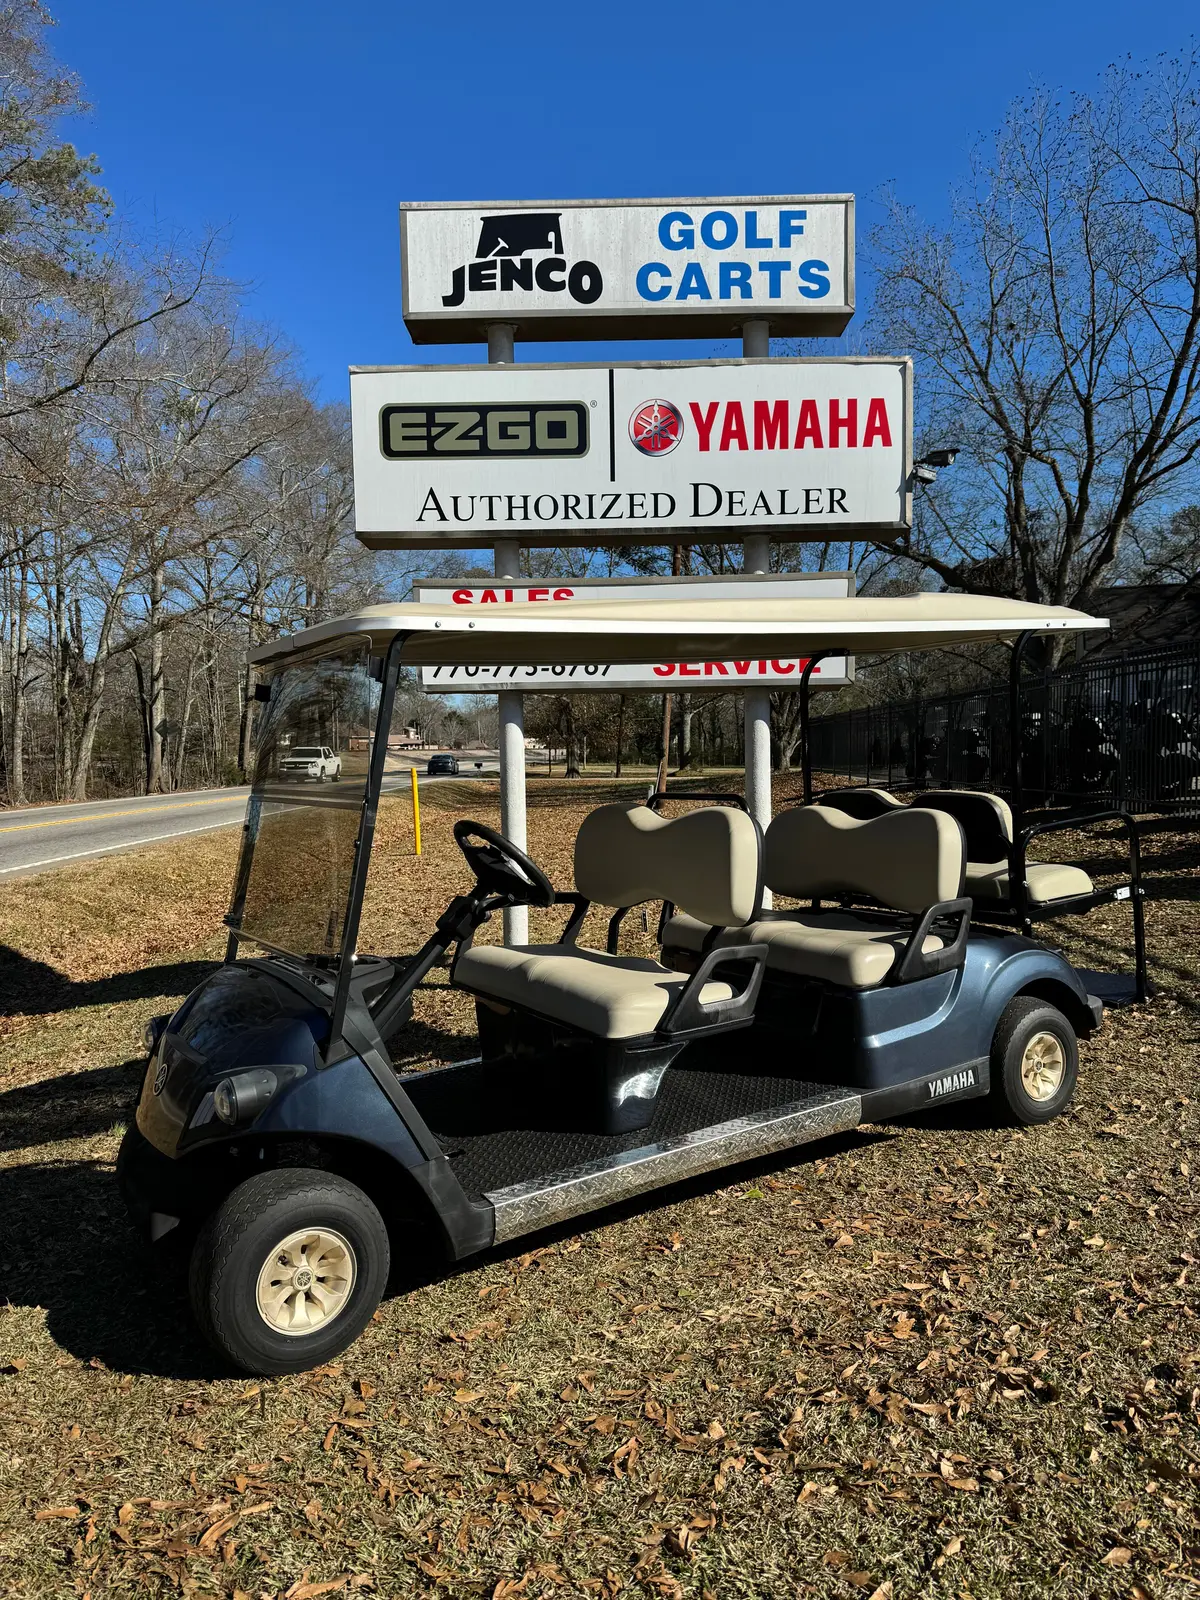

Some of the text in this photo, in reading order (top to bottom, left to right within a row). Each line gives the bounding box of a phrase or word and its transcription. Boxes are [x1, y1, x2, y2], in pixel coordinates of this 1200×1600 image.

[658, 210, 808, 251] GOLF
[441, 257, 603, 306] JENCO
[635, 259, 831, 301] CARTS
[689, 398, 892, 452] YAMAHA
[928, 1069, 975, 1098] YAMAHA
